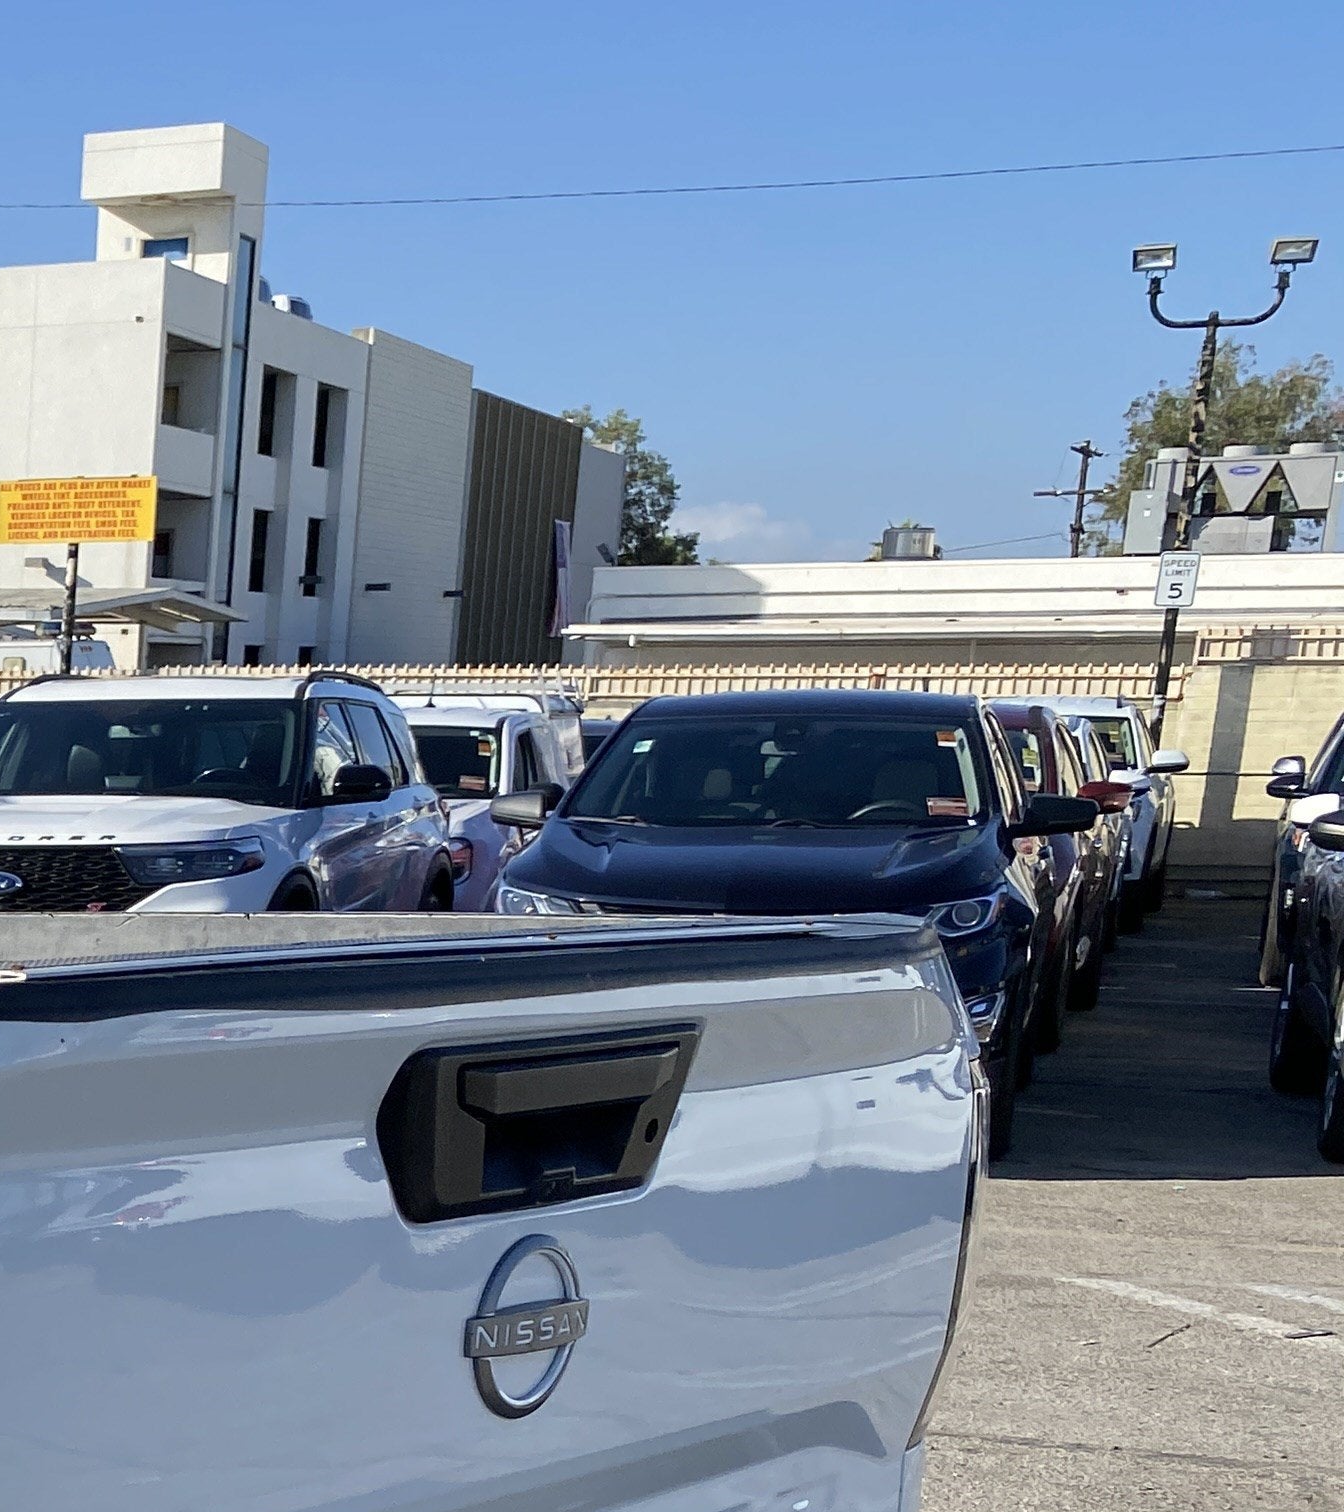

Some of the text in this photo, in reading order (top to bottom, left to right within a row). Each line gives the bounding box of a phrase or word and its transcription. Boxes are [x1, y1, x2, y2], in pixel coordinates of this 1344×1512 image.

[0, 483, 12, 492] ALL
[14, 482, 41, 491] PRICES
[43, 482, 57, 491] ARE
[59, 481, 78, 490] PLUS
[79, 481, 95, 490] ANY
[96, 480, 119, 489] AFTER
[49, 510, 82, 519] LOCATOR
[7, 521, 71, 530] DOCUMENTATION
[95, 520, 118, 528] SMOG
[43, 530, 59, 539] AND
[1163, 559, 1197, 567] SPEED
[1165, 569, 1193, 577] LIMIT
[1167, 582, 1184, 599] 5
[475, 1308, 586, 1349] NISSAN
